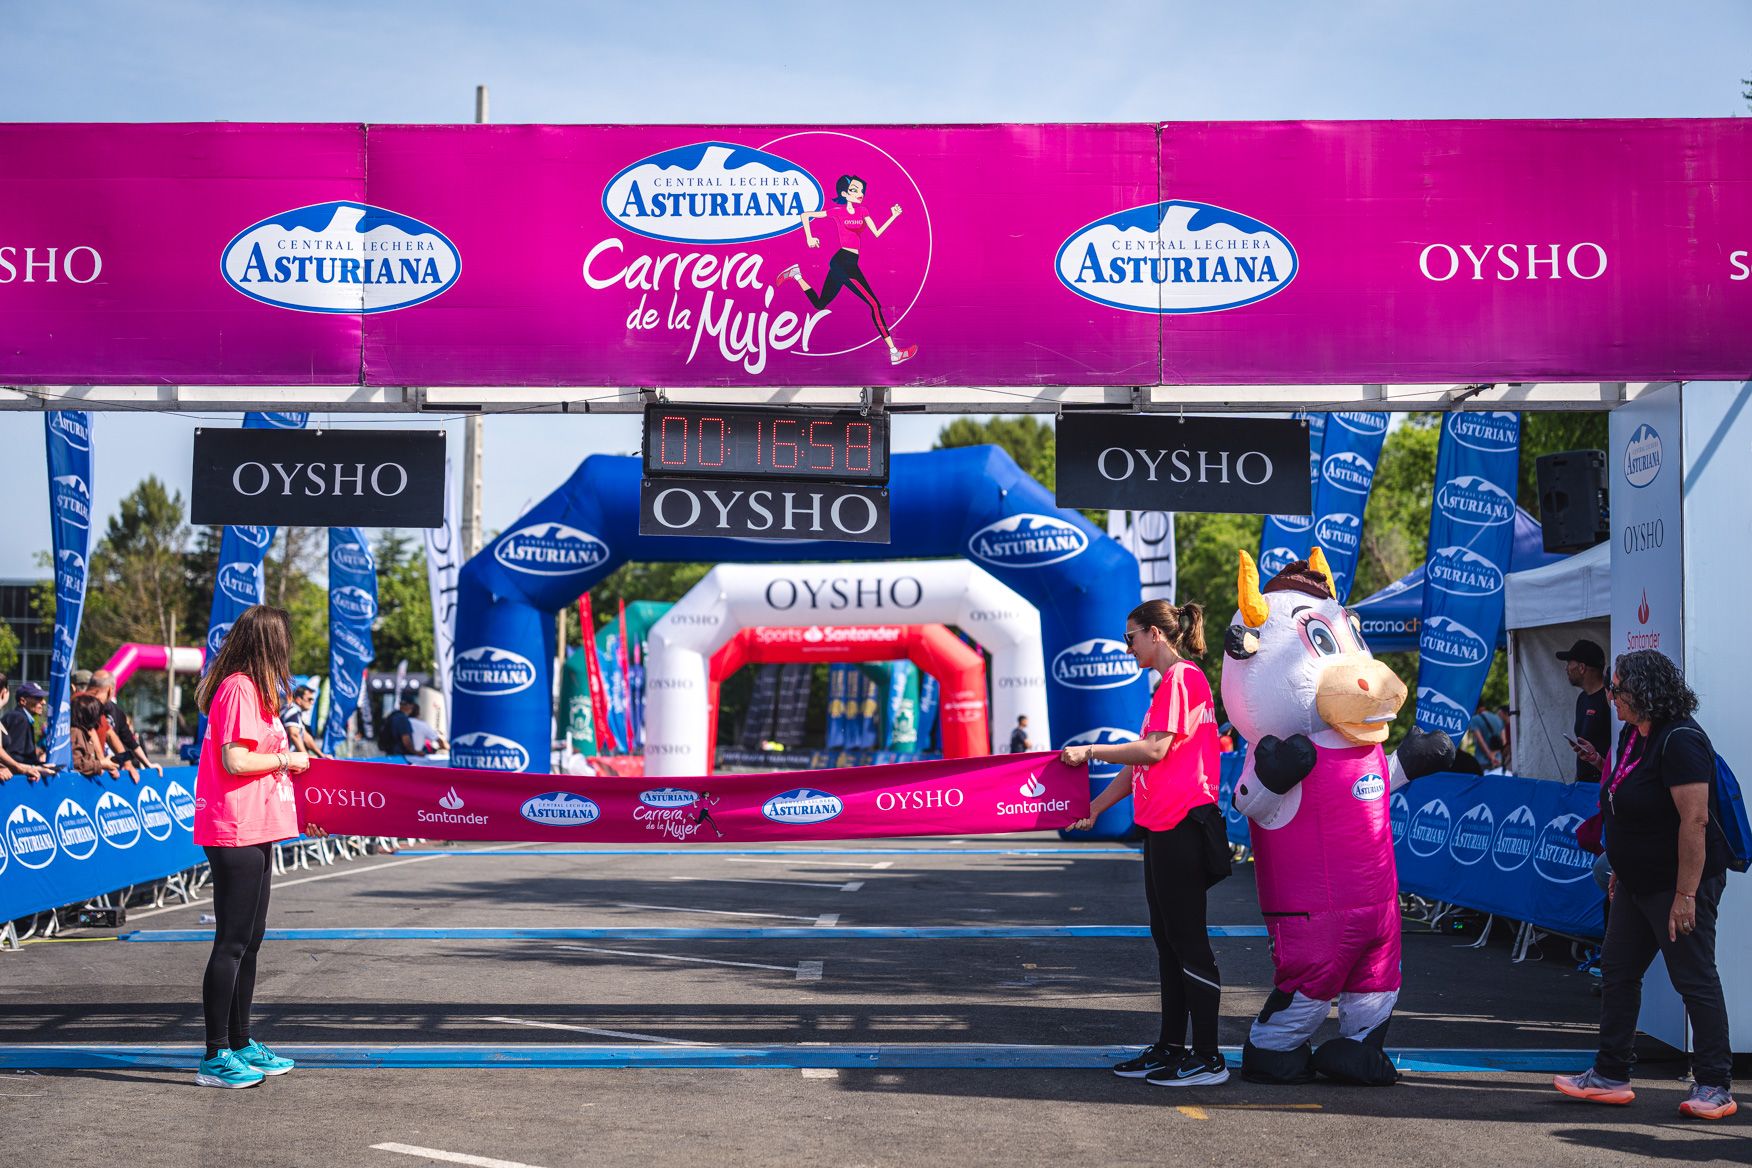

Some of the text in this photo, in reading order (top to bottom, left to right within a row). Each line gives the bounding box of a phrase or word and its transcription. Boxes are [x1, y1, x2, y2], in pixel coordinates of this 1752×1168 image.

[653, 176, 800, 188] CENTRAL LECHERA
[619, 179, 805, 218] ASTURIANA
[277, 239, 354, 251] CENTRAL
[1112, 239, 1271, 250] CENTRAL LECHERA
[239, 241, 443, 285] ASTURIANA
[582, 238, 764, 291] Carrera
[1074, 241, 1280, 284] ASTURIANA
[1418, 241, 1608, 282] OYSHO
[626, 286, 832, 375] de la Mujer
[1097, 447, 1274, 486] OYSHO
[1627, 449, 1660, 476] ASTURIANA
[232, 461, 408, 496] OYSHO
[653, 488, 878, 534] OYSHO
[981, 535, 1081, 557] ASTURIANA
[1624, 518, 1664, 555] OYSHO
[500, 539, 599, 564] ASTURIANA
[765, 576, 923, 610] OYSHO
[670, 615, 720, 626] OYSHO
[755, 625, 901, 644] Sports Santander
[1627, 632, 1660, 650] Santander
[1058, 659, 1139, 679] ASTURIANA
[304, 786, 386, 809] OYSHO
[644, 793, 695, 801] ASTURIANA
[769, 802, 838, 816] ASTURIANA
[875, 788, 964, 811] OYSHO
[996, 799, 1071, 816] Santander
[417, 809, 489, 825] Santander
[527, 803, 594, 818] ASTURIANA
[633, 806, 683, 820] Carrera
[59, 822, 96, 847] ASTURIANA
[100, 814, 139, 838] ASTURIANA
[646, 818, 702, 840] de la Mujer
[1410, 818, 1445, 844] ASTURIANA
[1452, 825, 1489, 850] ASTURIANA
[11, 829, 55, 855] ASTURIANA
[1494, 828, 1530, 856] ASTURIANA
[1536, 836, 1595, 869] ASTURIANA
